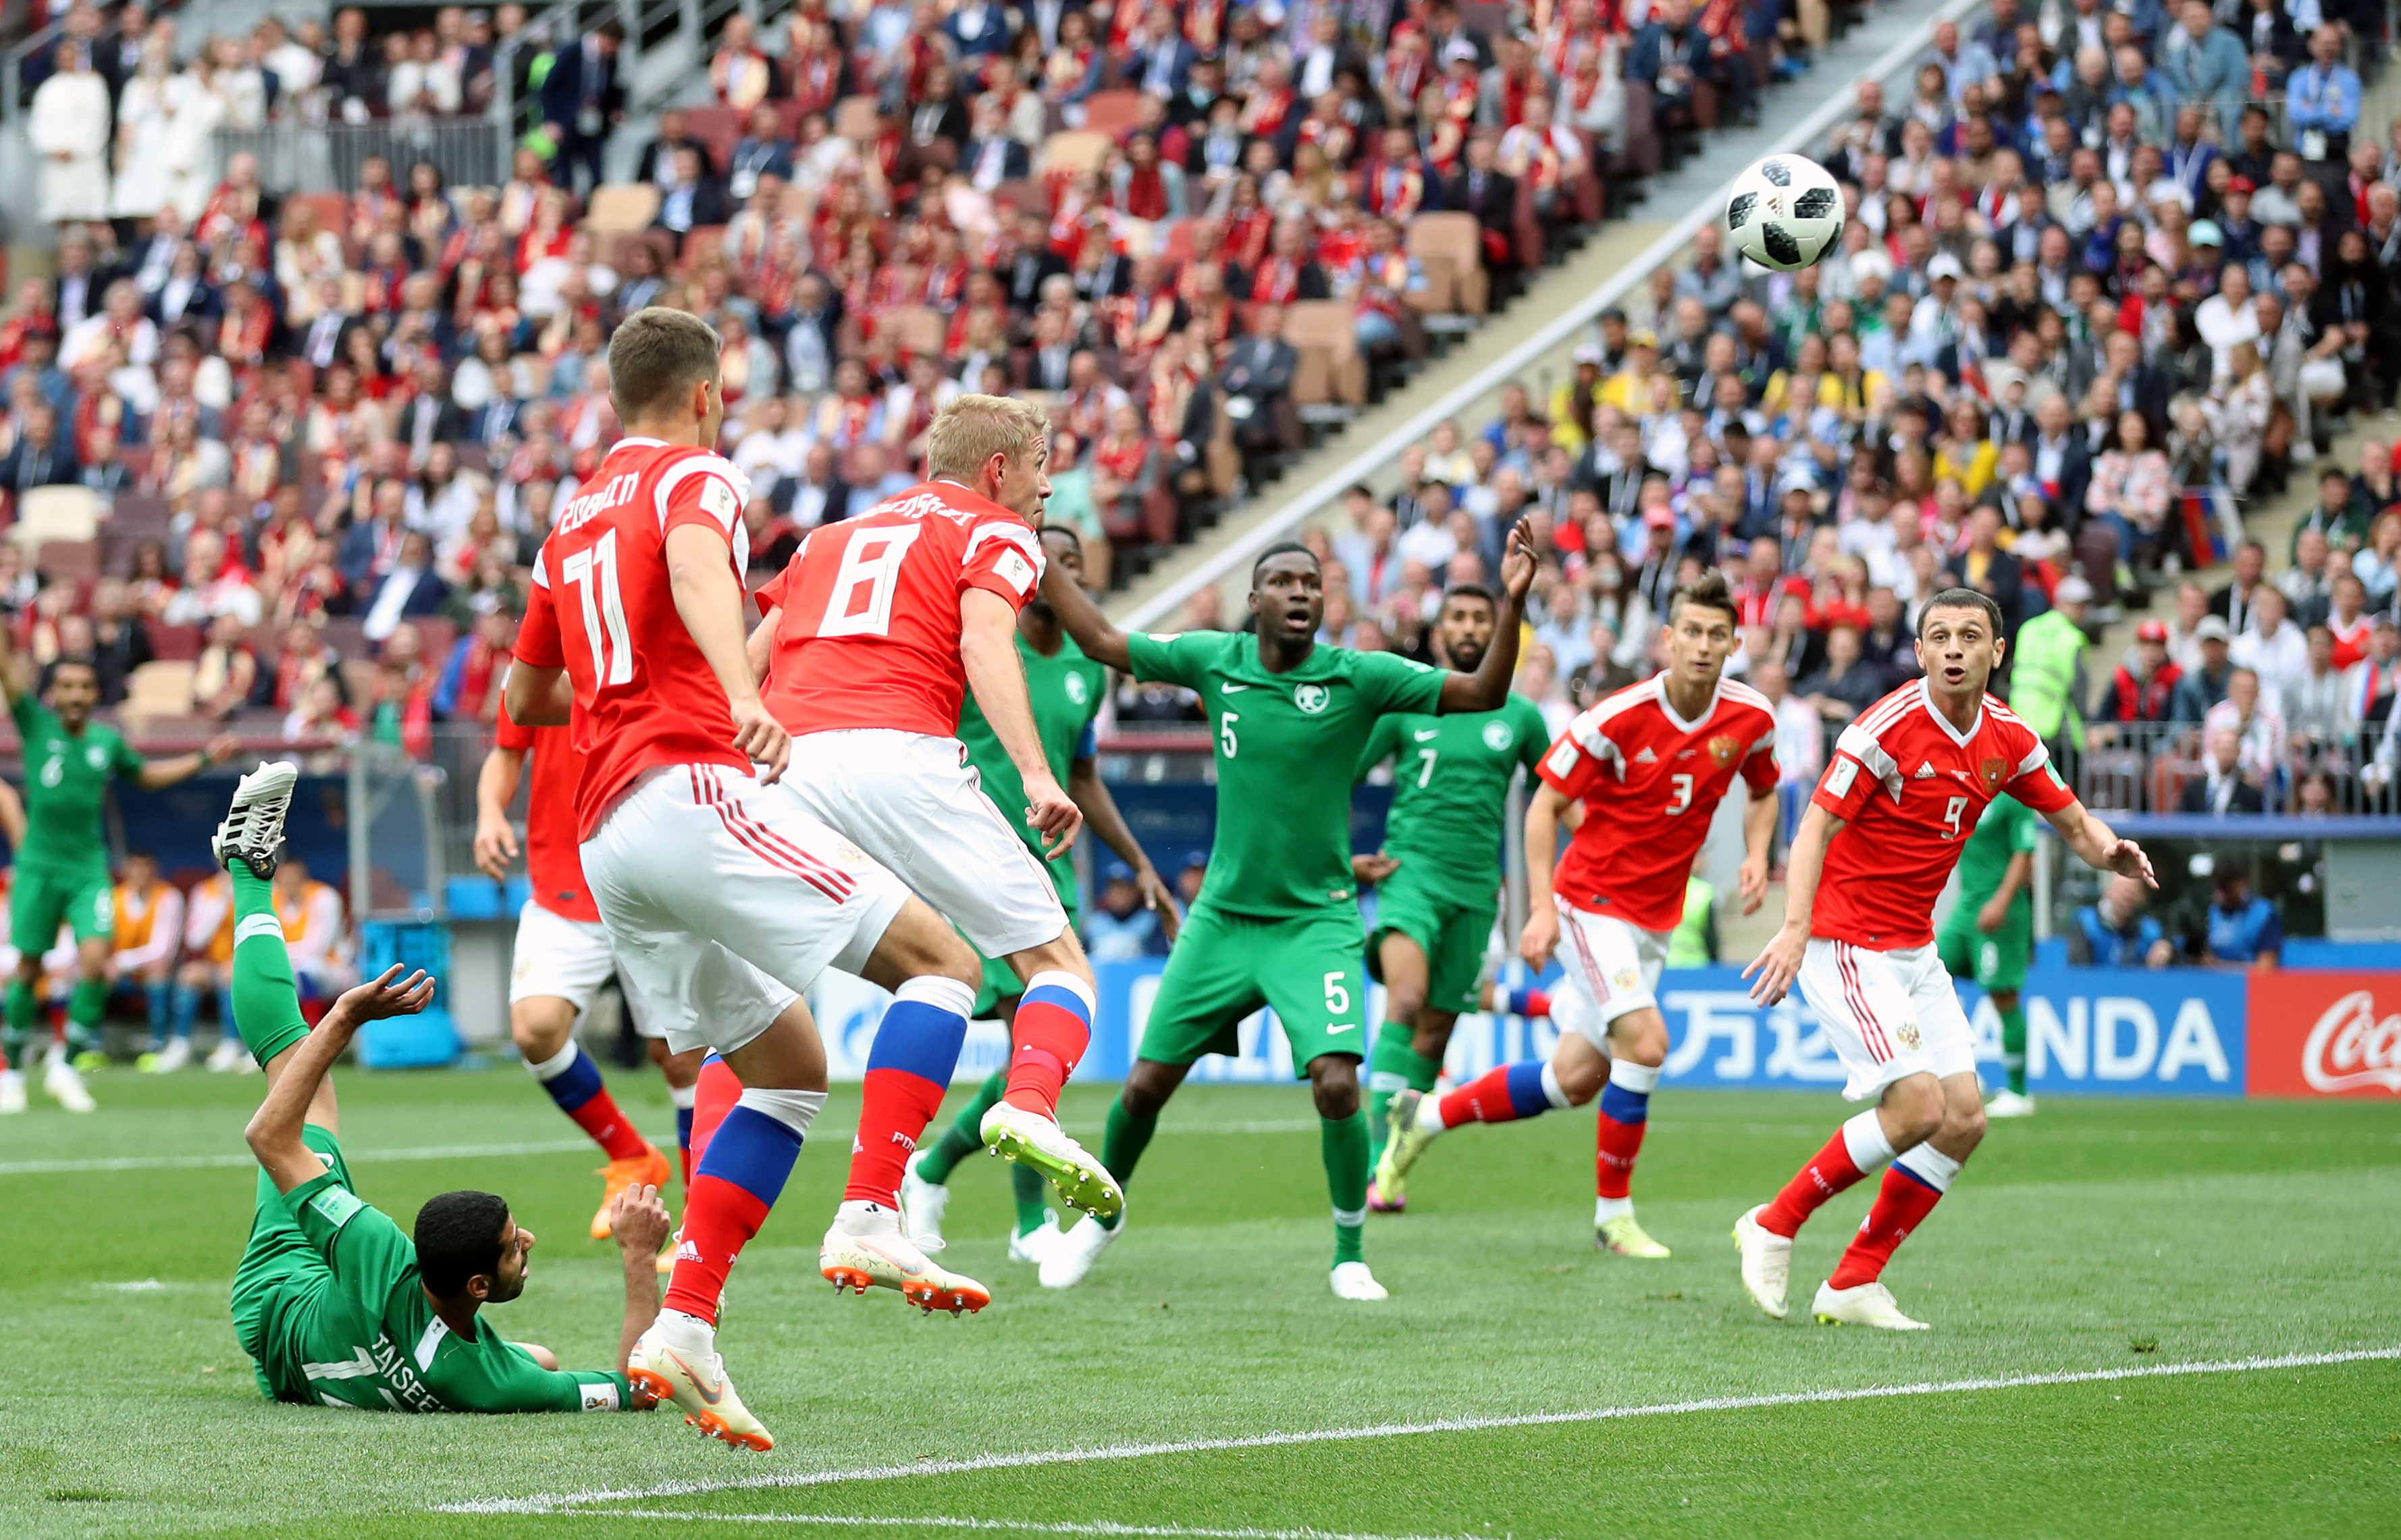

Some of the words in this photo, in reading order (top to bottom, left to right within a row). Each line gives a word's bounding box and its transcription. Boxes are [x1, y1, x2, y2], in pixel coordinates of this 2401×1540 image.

[816, 523, 922, 638] 8
[562, 527, 633, 693] 11
[1220, 711, 1240, 760] 5
[39, 753, 64, 789] 6
[1417, 748, 1438, 789] 7
[1665, 774, 1694, 816] 3
[1940, 796, 1969, 841] 9
[1323, 971, 1350, 1015] 5
[1957, 995, 2230, 1082] ANDA
[372, 1332, 450, 1412] TAISEE
